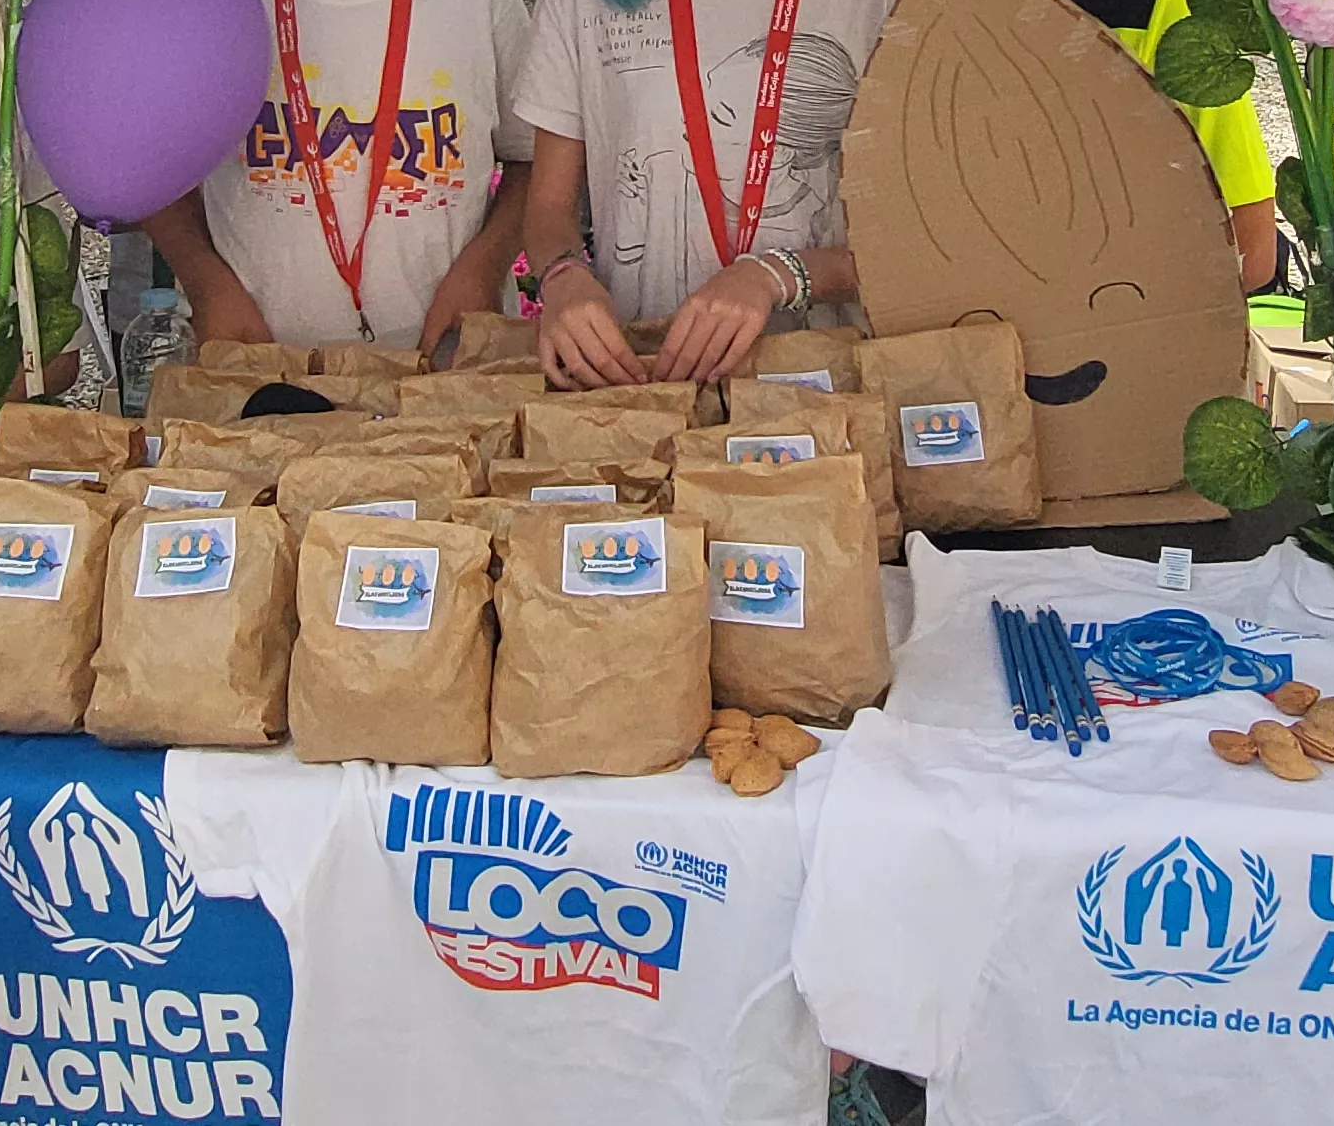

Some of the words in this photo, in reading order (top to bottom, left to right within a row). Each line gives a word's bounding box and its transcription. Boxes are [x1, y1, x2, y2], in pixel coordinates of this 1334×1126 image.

[672, 848, 728, 876] UNHCR
[672, 860, 727, 889] ACNUR
[427, 857, 675, 955] LOCO
[433, 932, 653, 993] FESTIVAL
[1067, 999, 1100, 1024] La
[1106, 1000, 1216, 1030] Agencia
[1224, 1007, 1257, 1032] de
[1267, 1012, 1291, 1035] la
[0, 1042, 282, 1119] ACNUR
